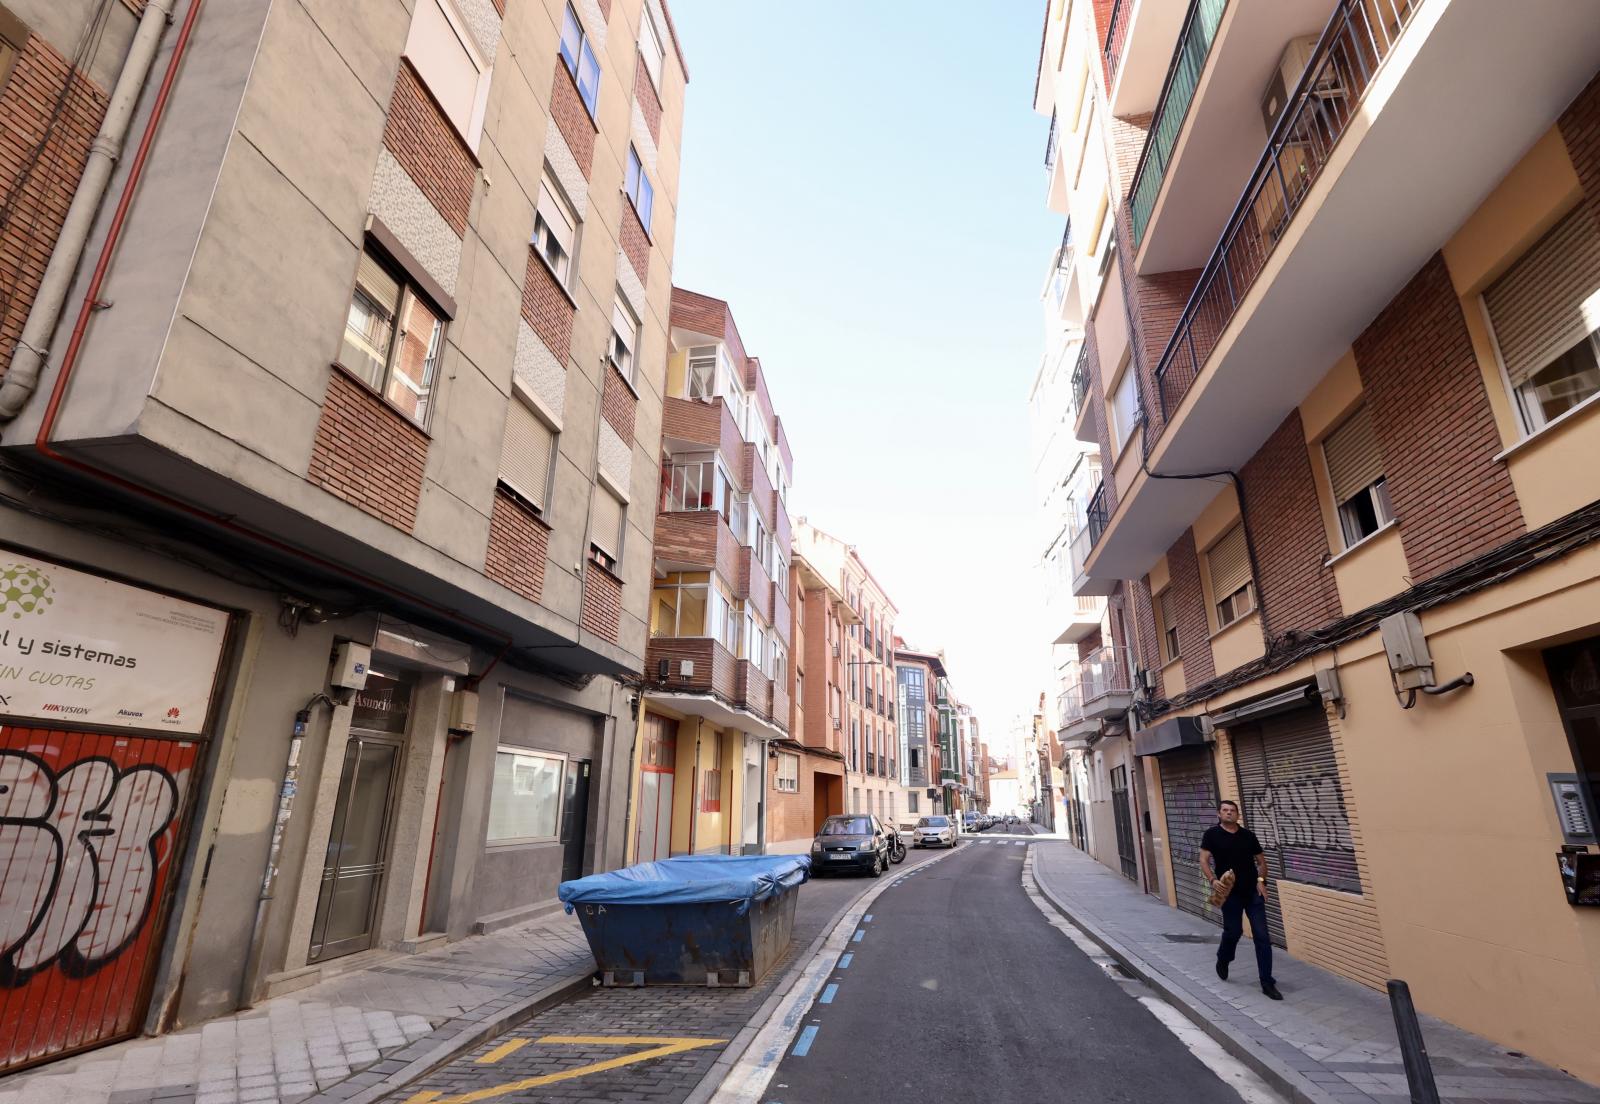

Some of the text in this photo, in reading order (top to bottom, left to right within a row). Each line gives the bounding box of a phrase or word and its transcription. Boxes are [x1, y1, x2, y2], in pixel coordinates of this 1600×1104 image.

[17, 637, 35, 655] y
[41, 639, 137, 669] sistemas
[28, 670, 96, 690] CUOTAS
[42, 703, 91, 716] HIKVISION
[117, 708, 144, 718] Akuvox
